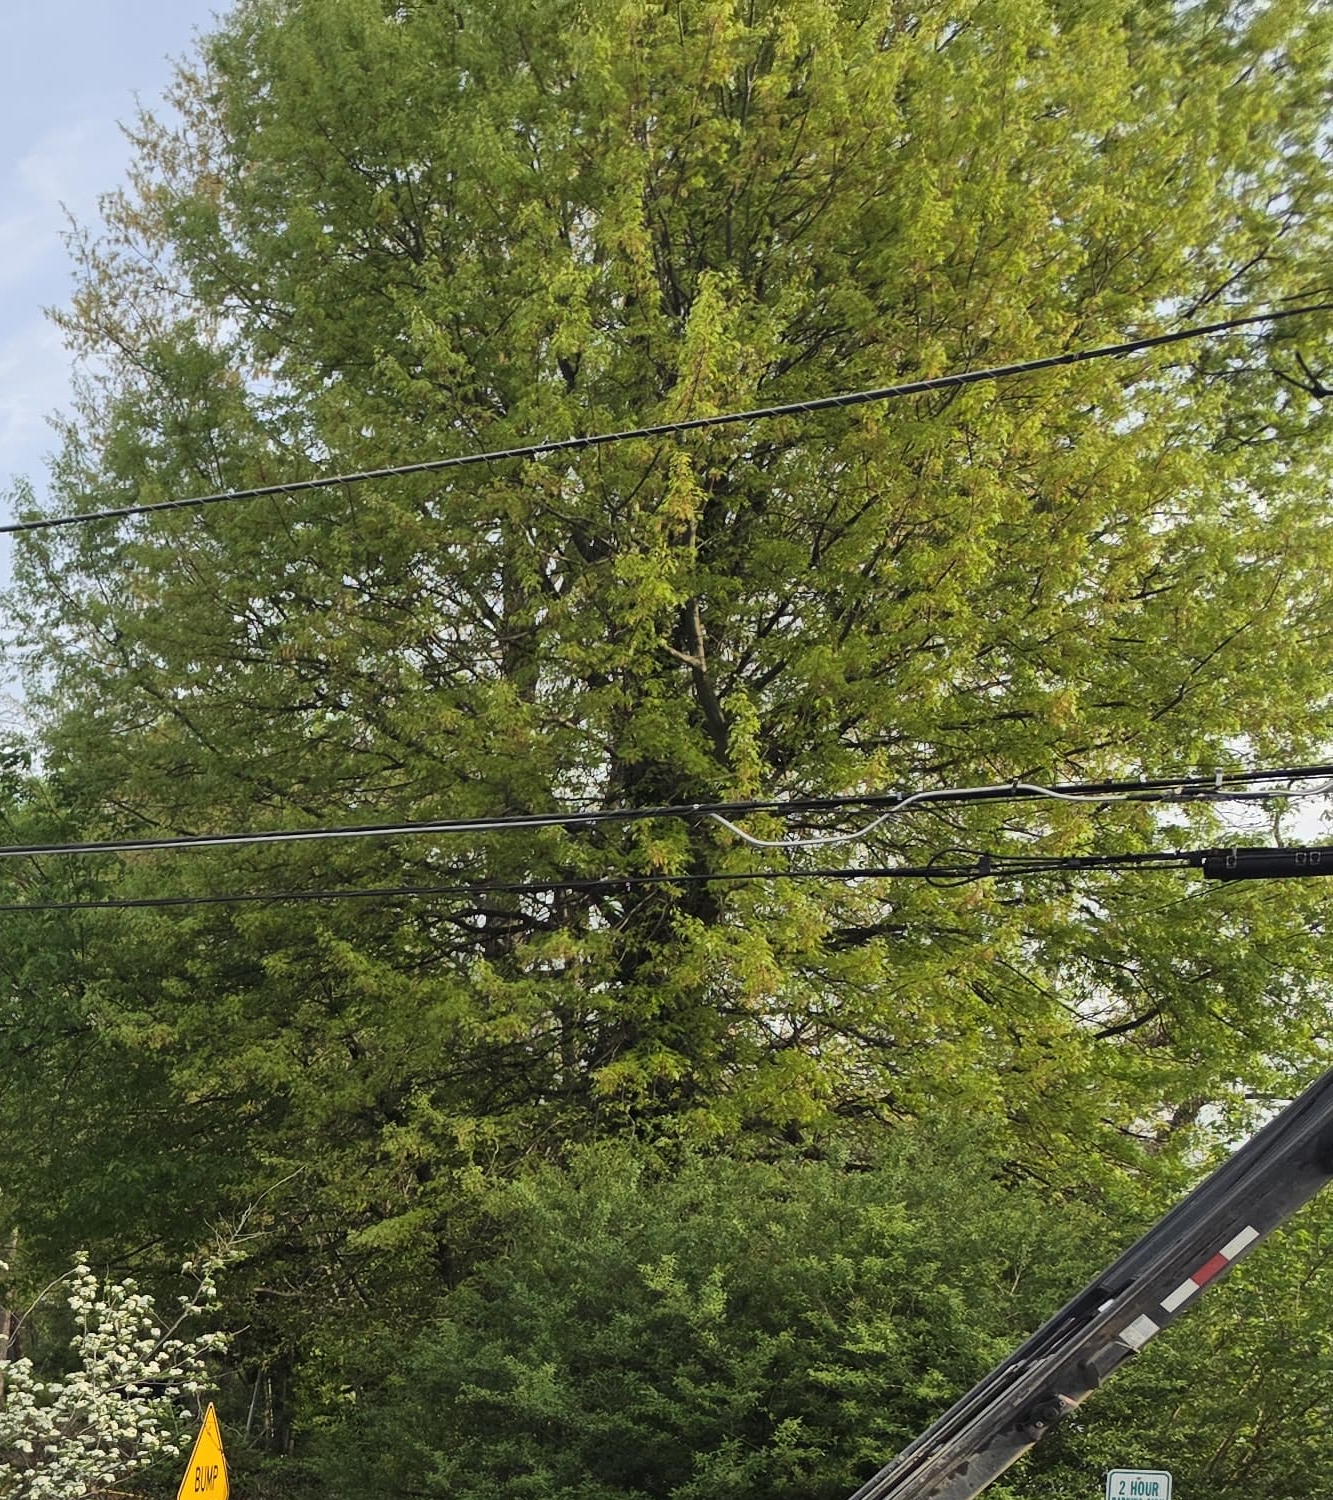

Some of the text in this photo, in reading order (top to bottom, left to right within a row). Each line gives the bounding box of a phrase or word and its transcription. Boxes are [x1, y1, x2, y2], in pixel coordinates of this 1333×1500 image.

[195, 1464, 219, 1492] BUMP
[1119, 1480, 1159, 1496] 2 HOUR
